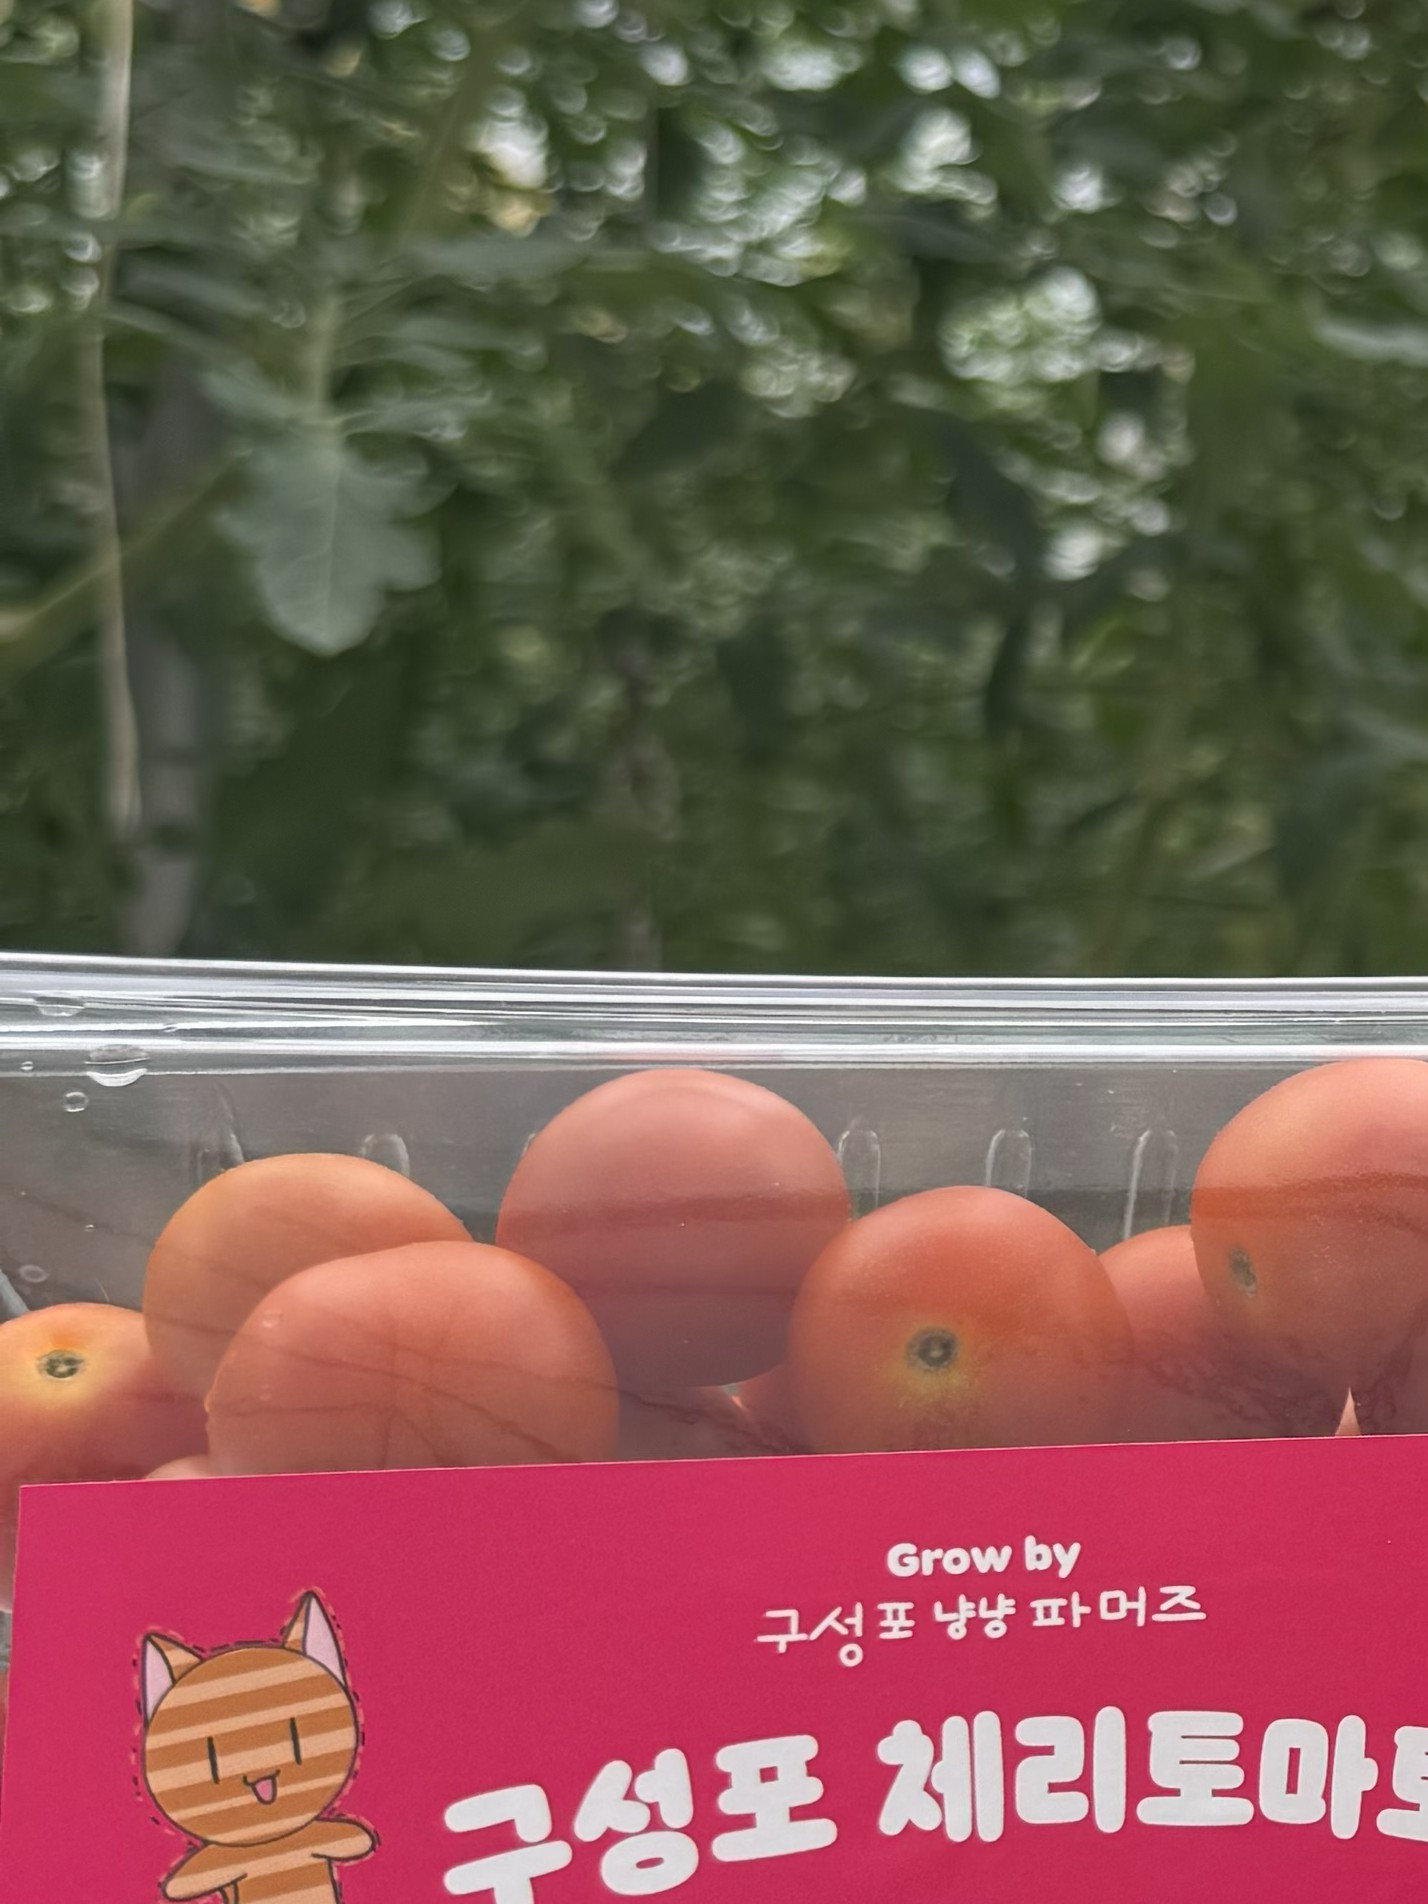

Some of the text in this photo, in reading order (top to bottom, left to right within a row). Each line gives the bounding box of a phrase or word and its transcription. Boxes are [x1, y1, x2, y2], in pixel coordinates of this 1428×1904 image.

[887, 1536, 1081, 1578] Grow by
[757, 1586, 1206, 1667] 구성포 냥냥 파머즈
